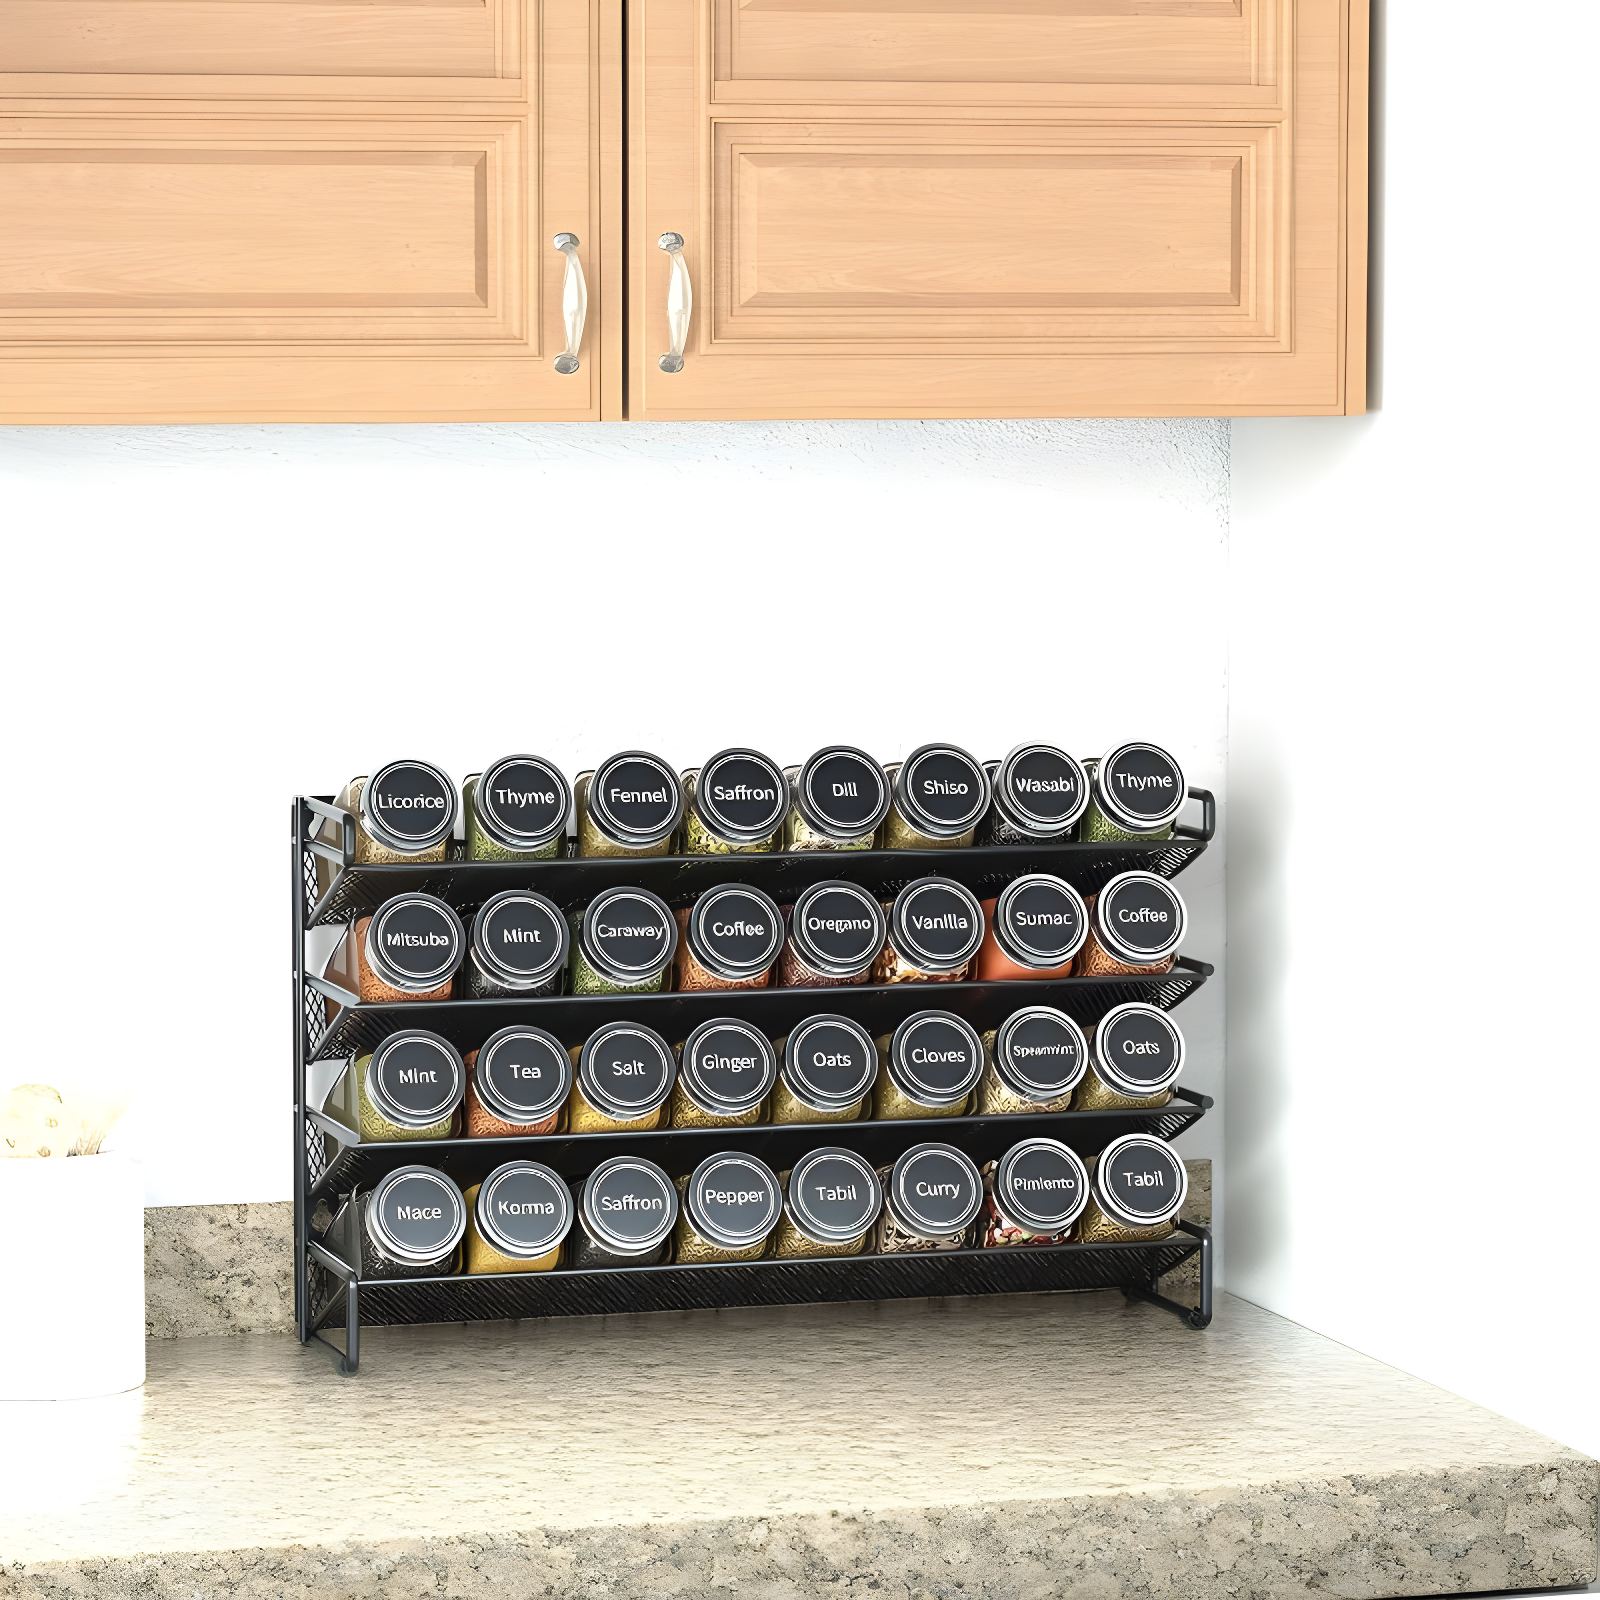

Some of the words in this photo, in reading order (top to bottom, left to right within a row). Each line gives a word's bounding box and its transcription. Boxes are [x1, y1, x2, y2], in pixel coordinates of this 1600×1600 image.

[832, 781, 858, 797] Dill
[923, 779, 969, 795] Shiso
[1015, 776, 1075, 793] Wasabi
[1115, 772, 1173, 792] Thyme
[378, 793, 445, 809] Licorice
[494, 788, 555, 809] Thyme
[610, 786, 668, 803] Fennel
[713, 784, 775, 801] Saffron
[911, 913, 969, 930] Vanilla
[1015, 911, 1073, 926] Sumac
[1118, 907, 1168, 923] Coffee
[597, 922, 664, 941] Caraway
[712, 920, 765, 937] Coffee
[807, 917, 872, 934] Oregano
[386, 931, 450, 947] Mitsuba
[503, 927, 542, 944] Mint
[911, 1047, 966, 1064] Cloves
[1122, 1039, 1161, 1055] Oats
[611, 1059, 646, 1076] Salt
[702, 1053, 758, 1073] Ginger
[812, 1051, 852, 1067] Oats
[398, 1067, 438, 1084] Mint
[509, 1064, 542, 1079] Tea
[1013, 1176, 1075, 1191] Pimiento
[1122, 1170, 1164, 1187] Tabil
[705, 1189, 765, 1206] Pepper
[814, 1184, 857, 1201] Tabil
[915, 1181, 960, 1200] Curry
[498, 1200, 555, 1215] Korma
[601, 1193, 663, 1211] Saffron
[397, 1205, 442, 1221] Mace
